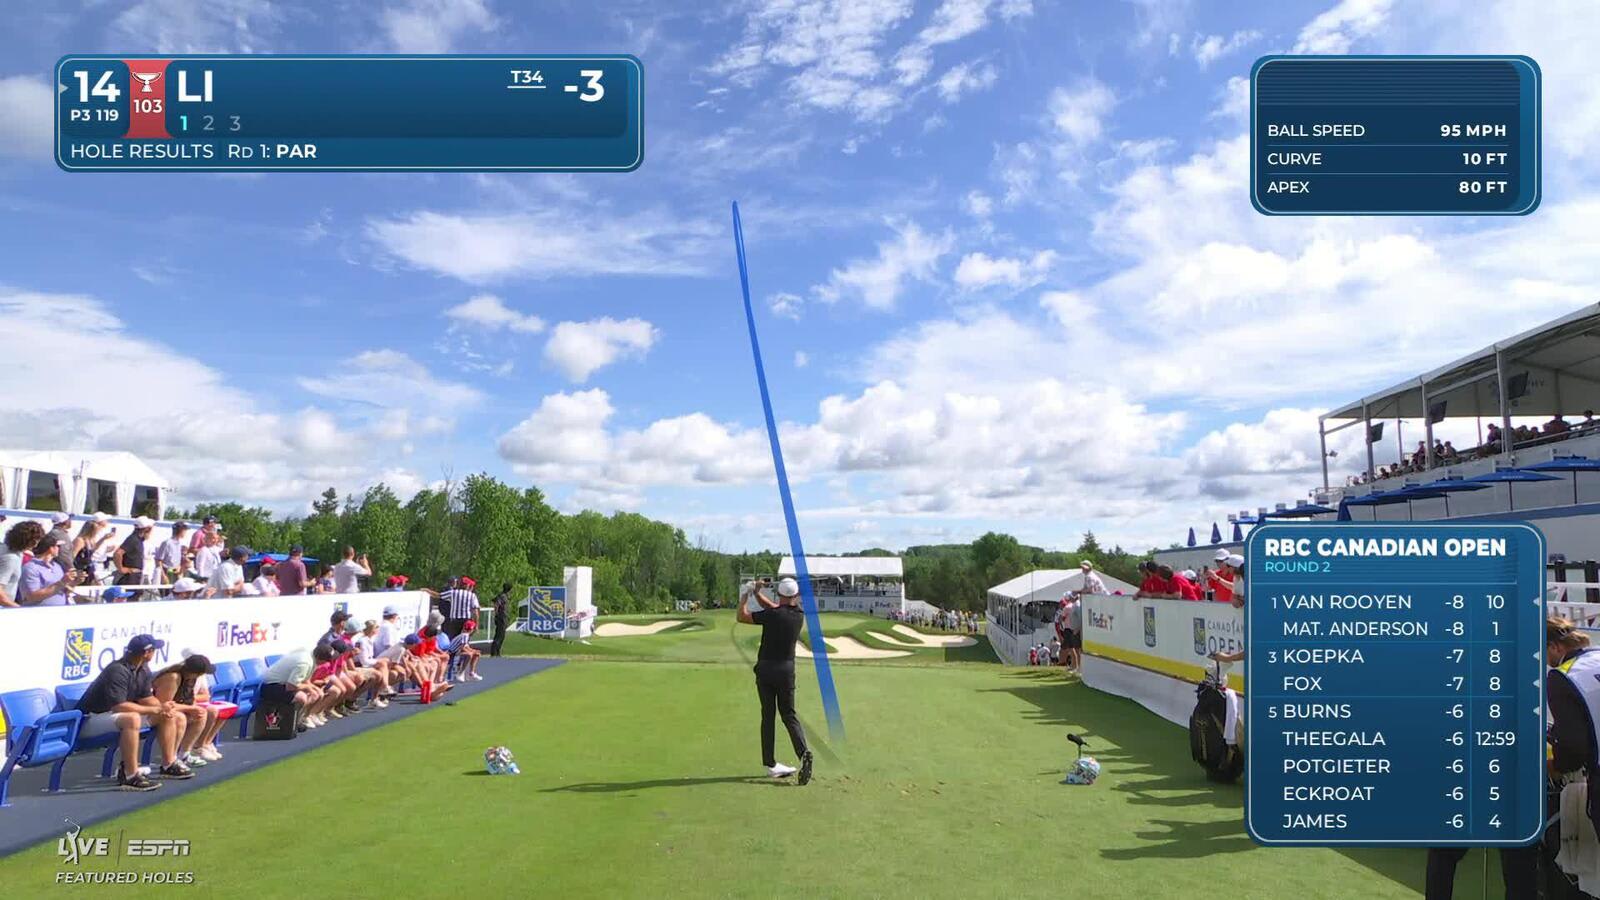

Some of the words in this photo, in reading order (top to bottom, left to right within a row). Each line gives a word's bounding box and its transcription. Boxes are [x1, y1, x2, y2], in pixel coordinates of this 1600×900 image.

[101, 620, 172, 640] CANADIAN
[231, 622, 267, 646] FedEx
[532, 620, 563, 631] RBC
[64, 664, 89, 679] RBC
